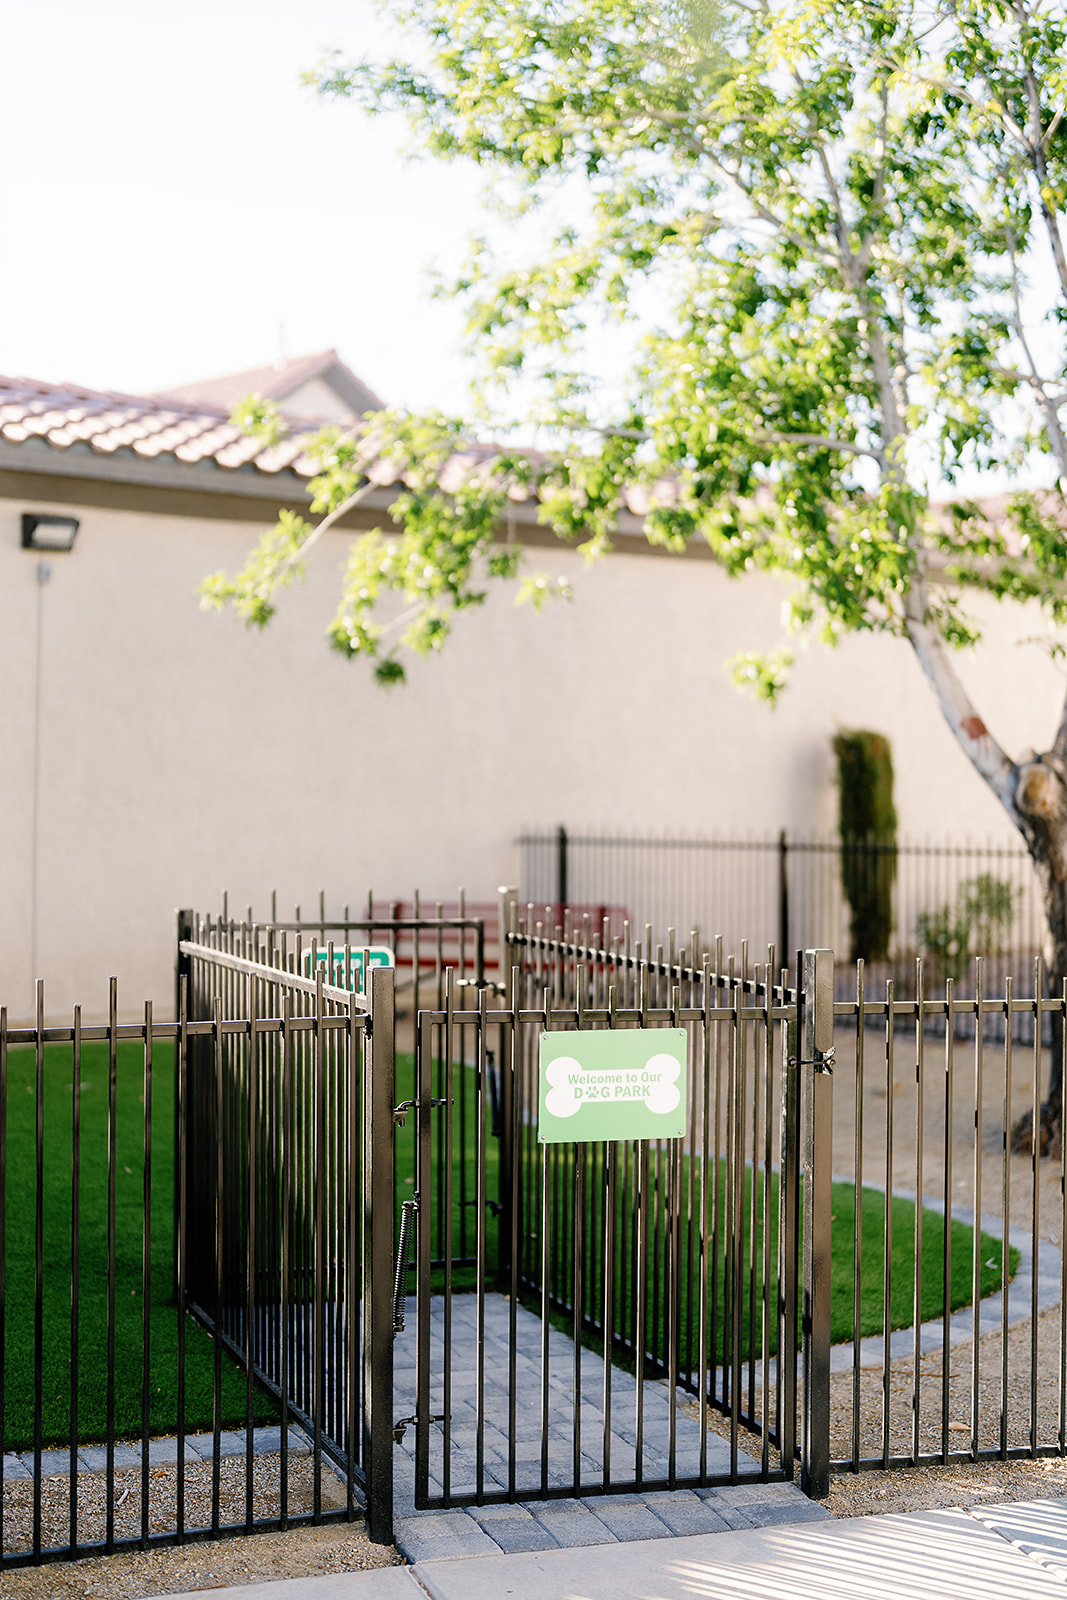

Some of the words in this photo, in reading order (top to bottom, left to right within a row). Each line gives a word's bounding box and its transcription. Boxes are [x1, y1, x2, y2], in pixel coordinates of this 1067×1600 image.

[567, 1073, 623, 1085] Welcome
[626, 1073, 638, 1083] to
[641, 1072, 663, 1082] Our
[614, 1085, 651, 1098] PARK
